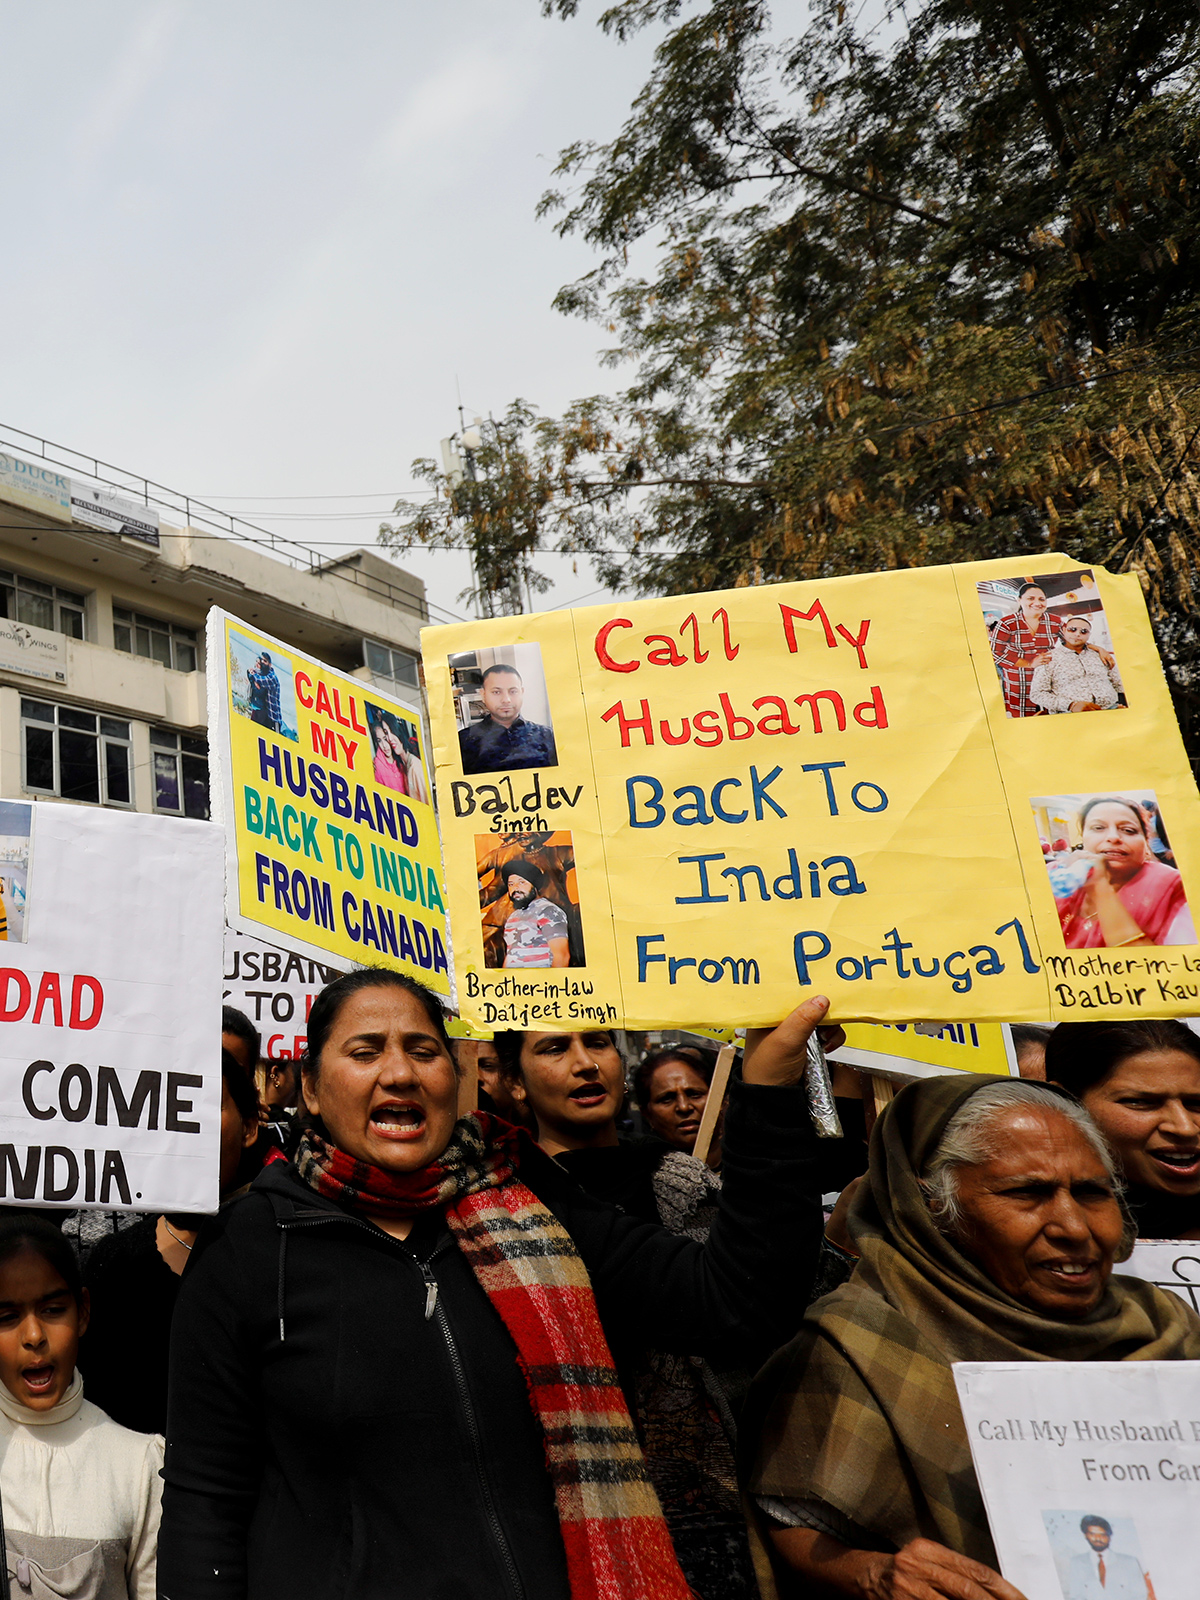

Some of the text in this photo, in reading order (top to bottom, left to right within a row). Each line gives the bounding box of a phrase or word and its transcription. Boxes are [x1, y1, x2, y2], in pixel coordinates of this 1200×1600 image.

[15, 460, 68, 490] DUCK
[30, 639, 58, 652] WINGS
[593, 597, 872, 674] Call My
[294, 670, 367, 737] CALL
[600, 684, 889, 748] Husband
[310, 720, 358, 771] MY
[258, 736, 419, 848] HUSBAND
[450, 772, 584, 819] Baldev
[801, 761, 889, 817] To
[488, 813, 548, 833] Singh
[244, 785, 445, 916] BACK TO INDIA
[674, 848, 867, 905] India
[254, 851, 449, 976] FROM CANADA
[636, 917, 1041, 993] From Portugal
[245, 991, 295, 1023] TO
[465, 972, 594, 998] Brother-in-law
[1054, 980, 1146, 1008] Balbir
[483, 1000, 617, 1027] Daljeet Singh
[22, 1060, 203, 1134] COME
[978, 1419, 1024, 1441] Call
[1030, 1420, 1068, 1447] My
[1073, 1420, 1185, 1441] Husband
[1082, 1458, 1150, 1481] From
